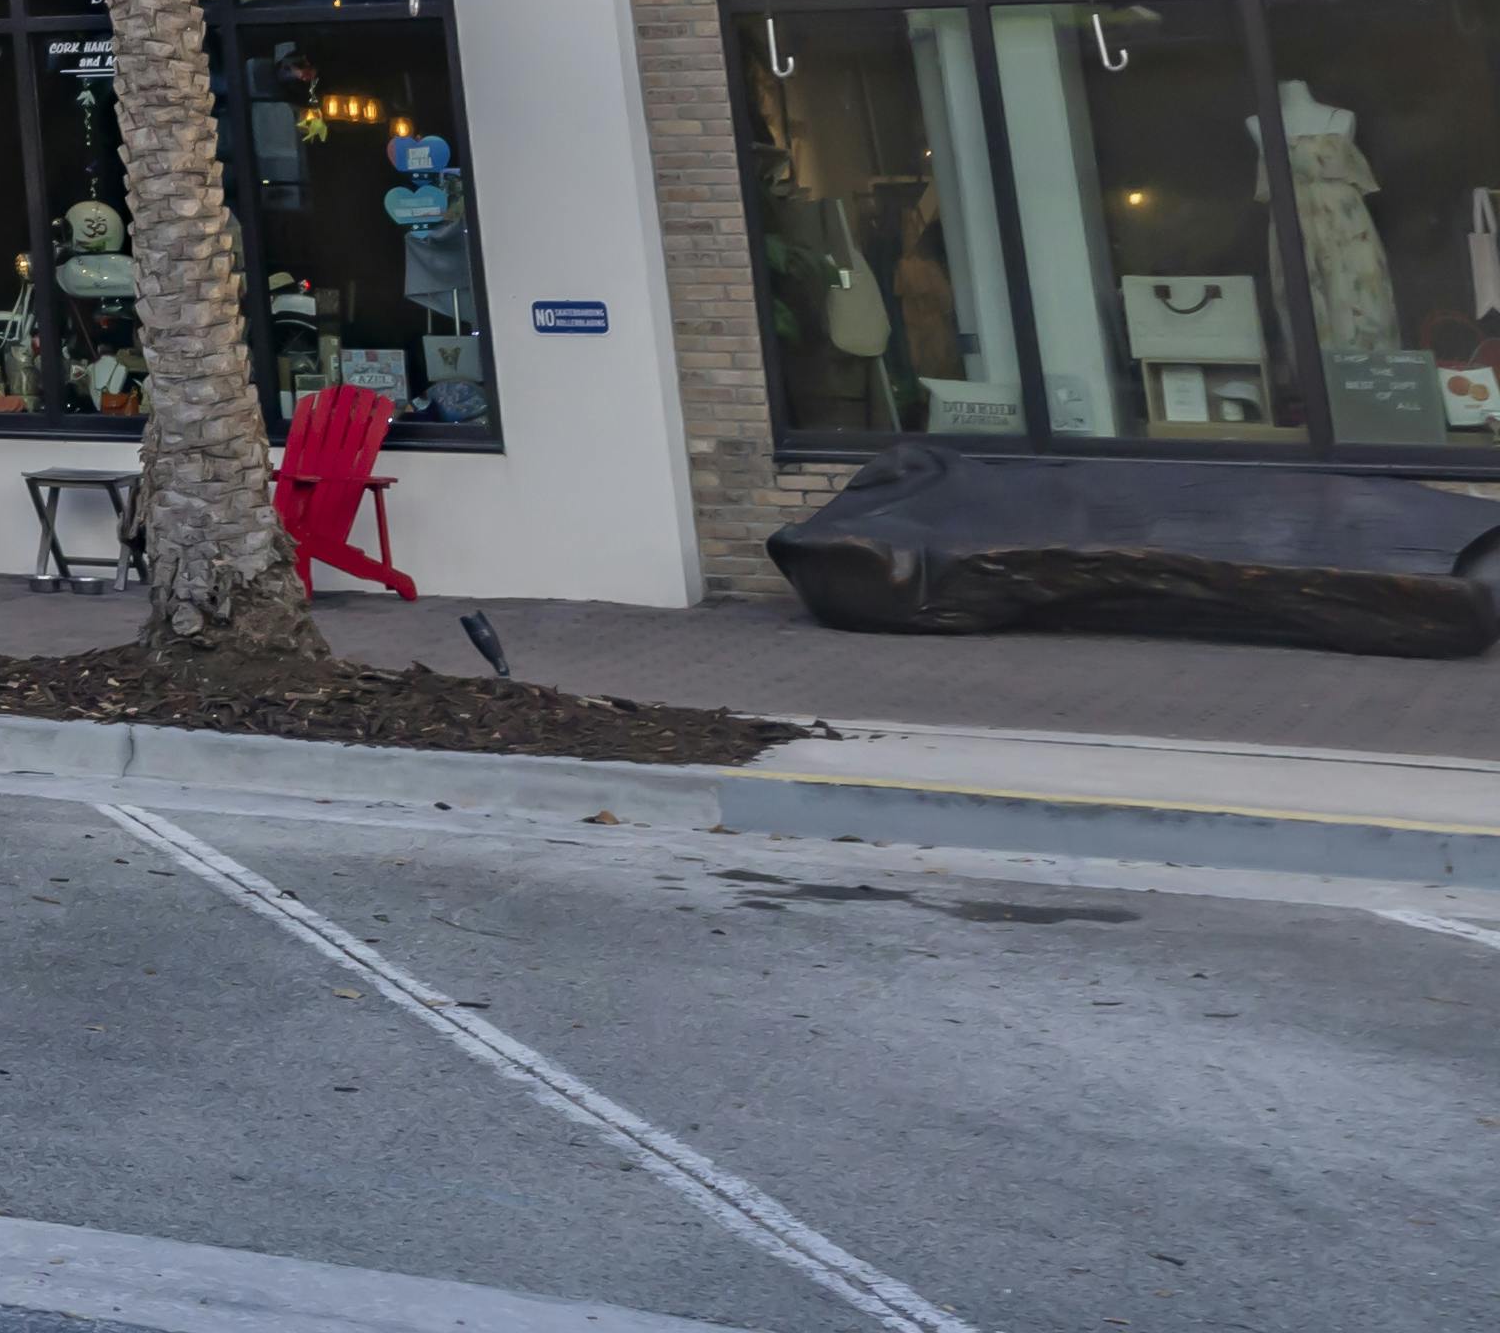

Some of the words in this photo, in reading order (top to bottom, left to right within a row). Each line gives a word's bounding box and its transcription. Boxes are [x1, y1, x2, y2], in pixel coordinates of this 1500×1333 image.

[50, 42, 80, 54] CORK
[84, 41, 112, 53] HAND
[79, 56, 100, 68] and
[535, 308, 555, 326] NO
